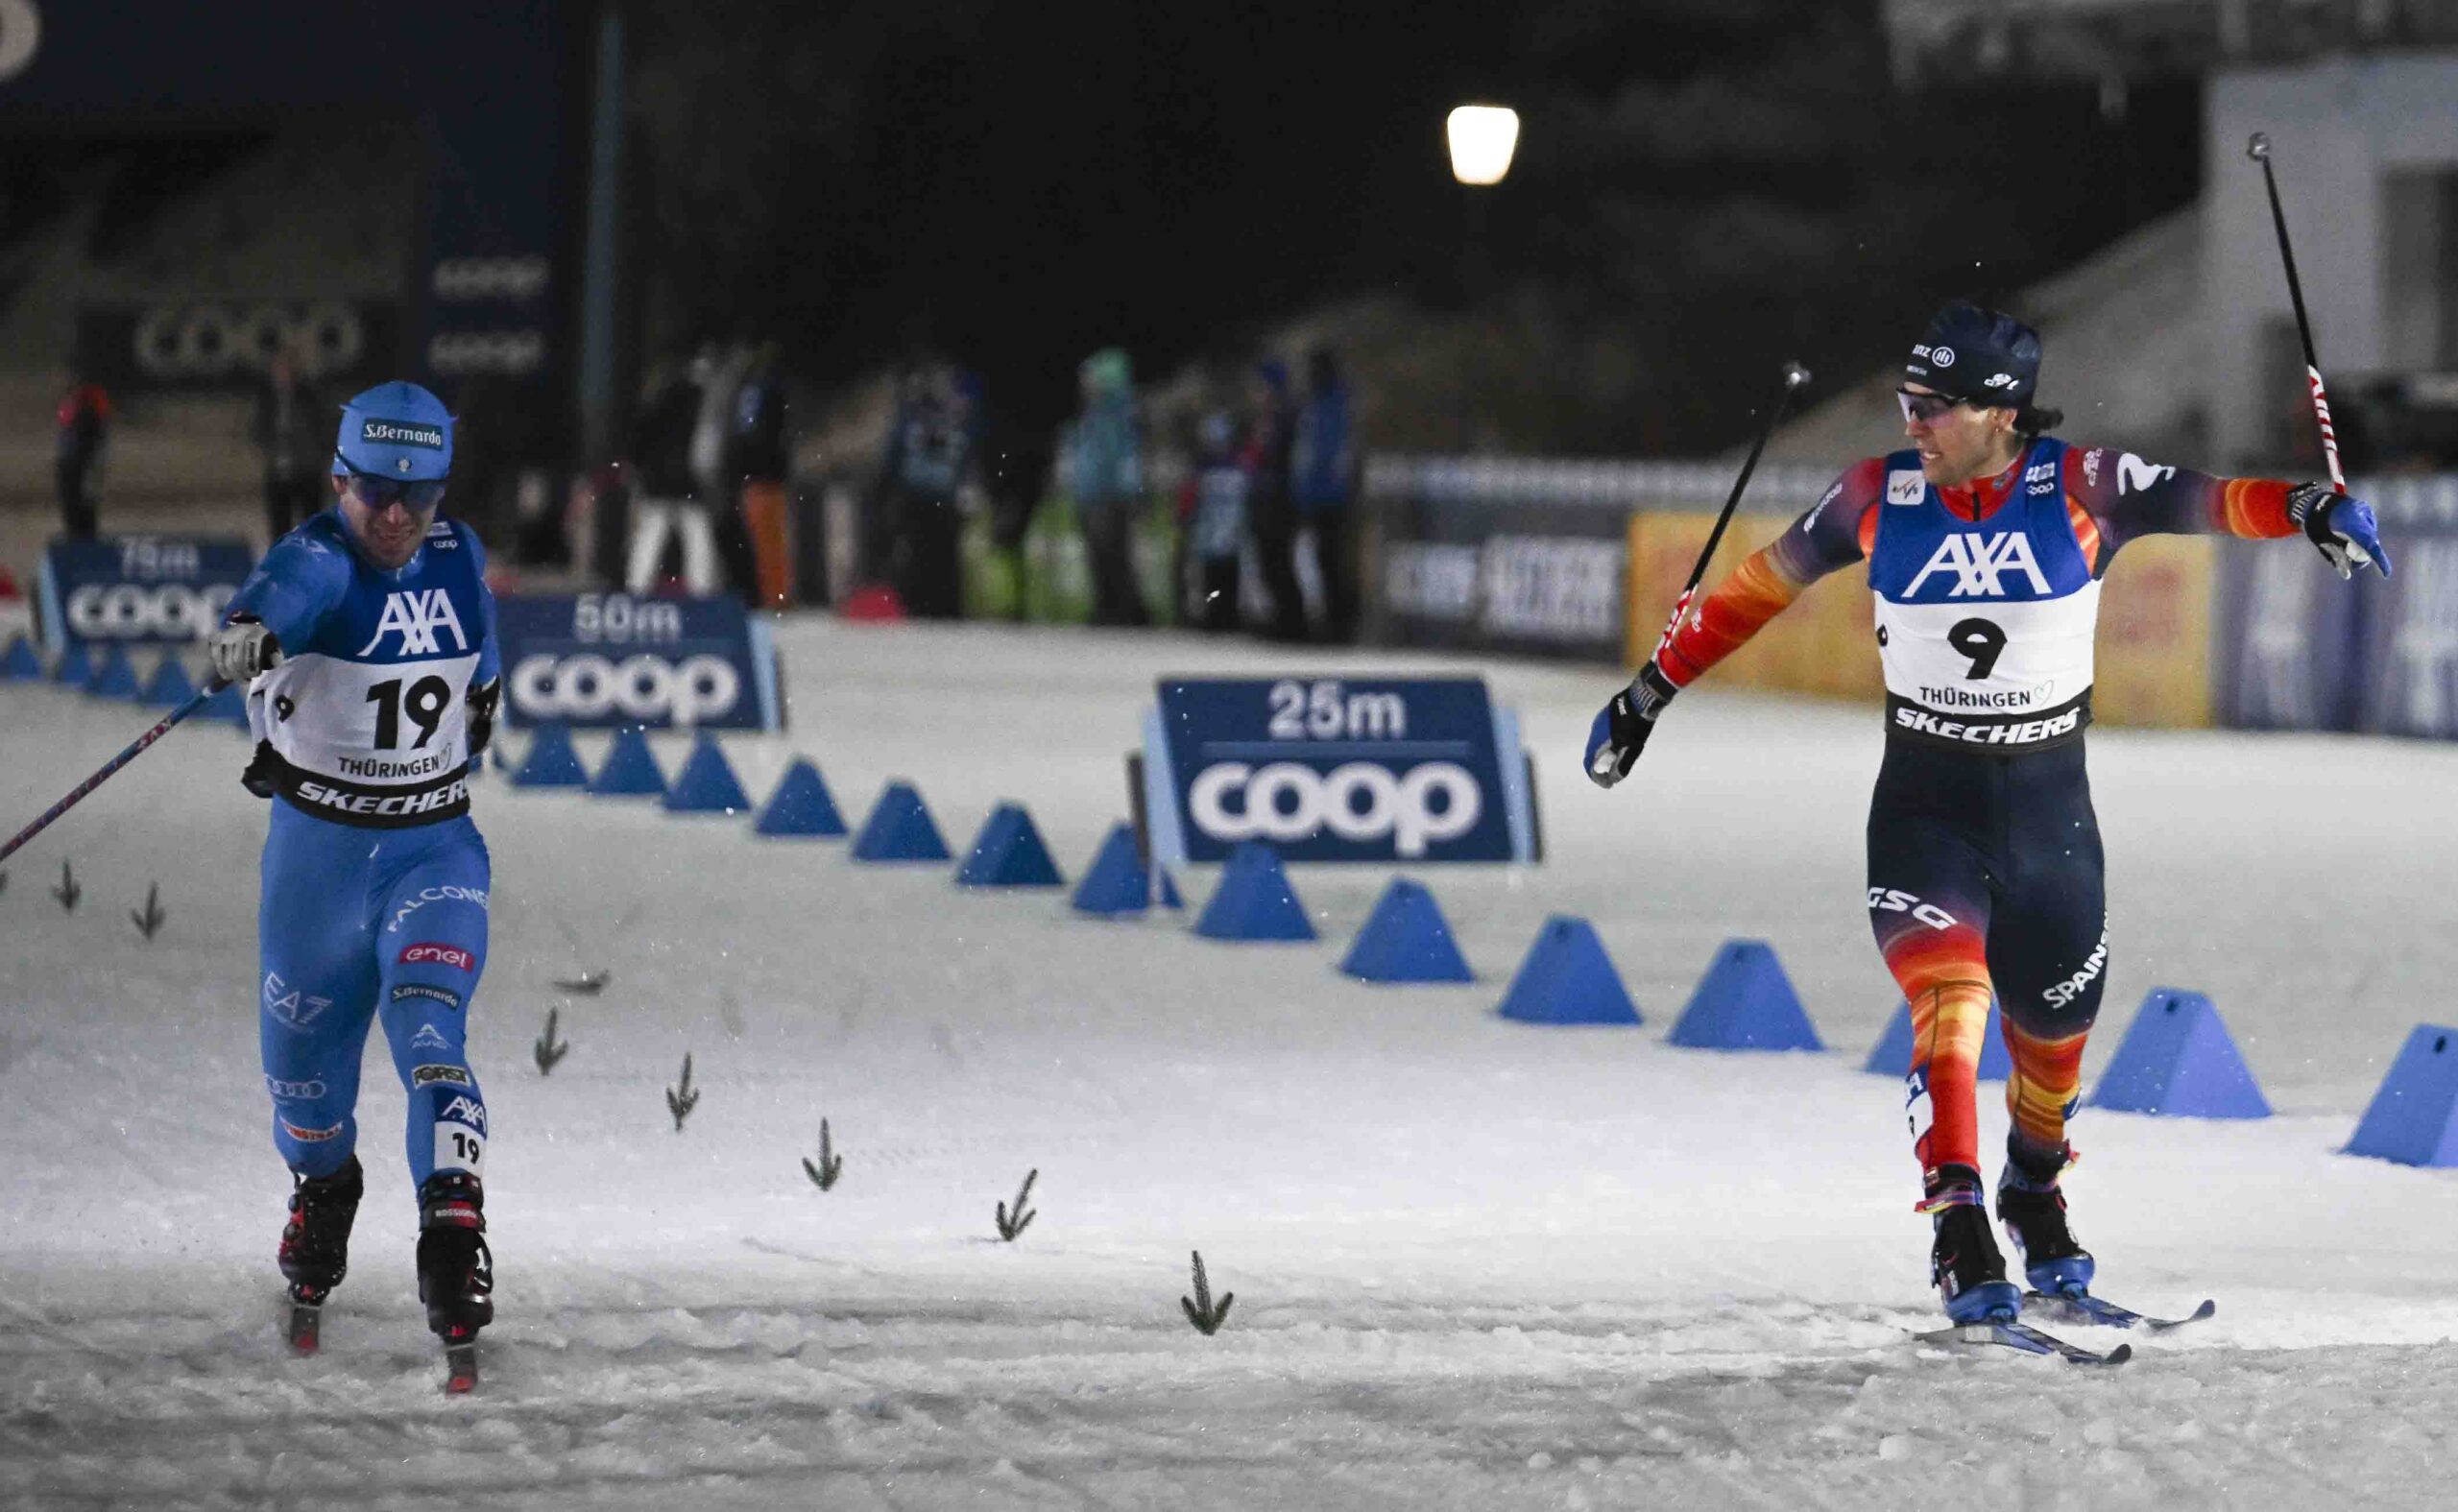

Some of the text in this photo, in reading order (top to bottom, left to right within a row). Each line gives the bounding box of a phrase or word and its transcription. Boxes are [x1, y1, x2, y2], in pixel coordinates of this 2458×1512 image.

[364, 423, 442, 446] S.Bernardo
[122, 536, 200, 577] 75m
[1900, 532, 2054, 598] AXA
[356, 588, 469, 657] AXA
[575, 592, 681, 643] 50m
[1946, 617, 2009, 680] 9
[510, 653, 739, 725] coop
[1267, 680, 1406, 739] 25m
[1919, 685, 2032, 708] THÜRINGEN
[366, 675, 451, 751] 19
[1894, 706, 2081, 745] SKECHERS
[338, 756, 440, 779] THÜRINGEN
[1189, 760, 1482, 857] coop
[406, 947, 468, 969] enel
[2042, 943, 2108, 1009] SPAIN
[392, 985, 458, 1008] S.Bernardo
[441, 1094, 488, 1135] AXA
[452, 1132, 480, 1165] 19
